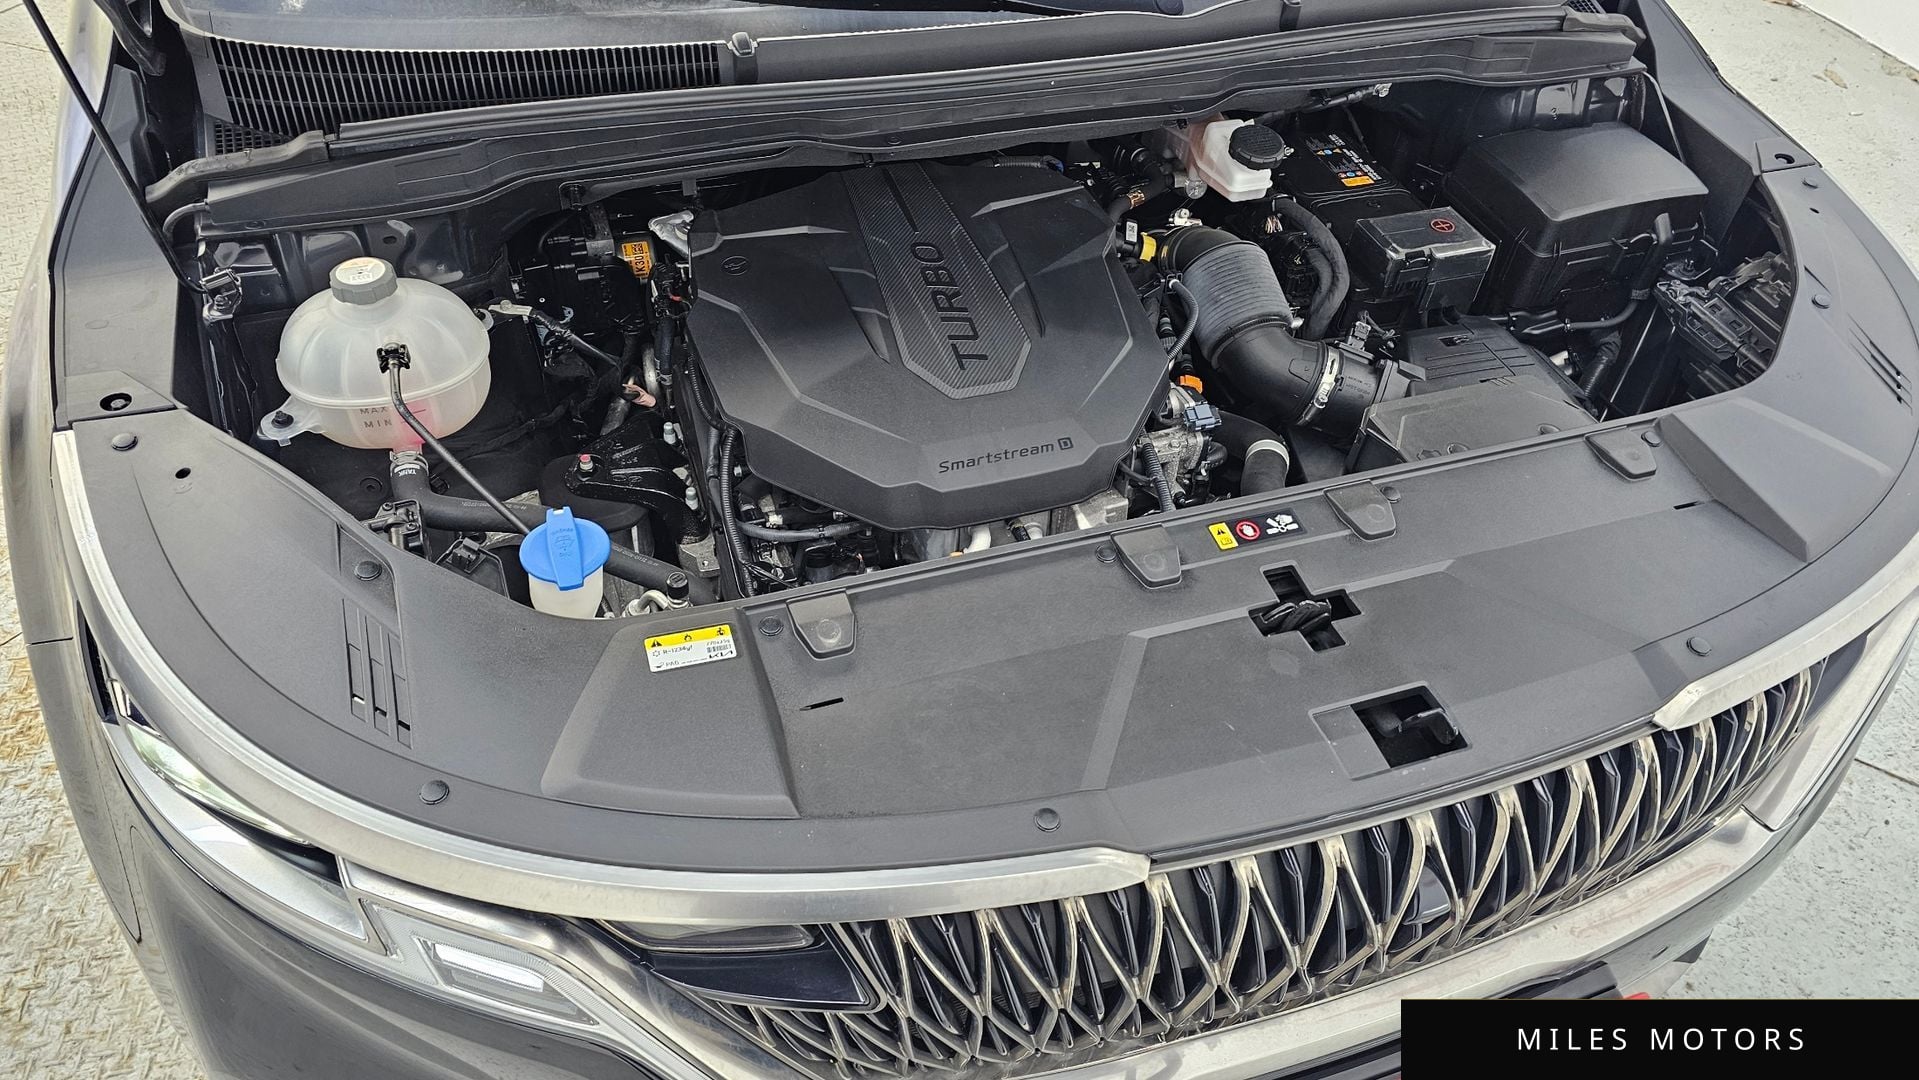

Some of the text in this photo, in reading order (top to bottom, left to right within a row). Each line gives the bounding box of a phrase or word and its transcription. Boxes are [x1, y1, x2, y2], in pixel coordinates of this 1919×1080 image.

[911, 242, 988, 371] TURBO
[360, 406, 388, 415] MAX
[364, 420, 392, 428] MIN
[938, 442, 1055, 474] Smartstream
